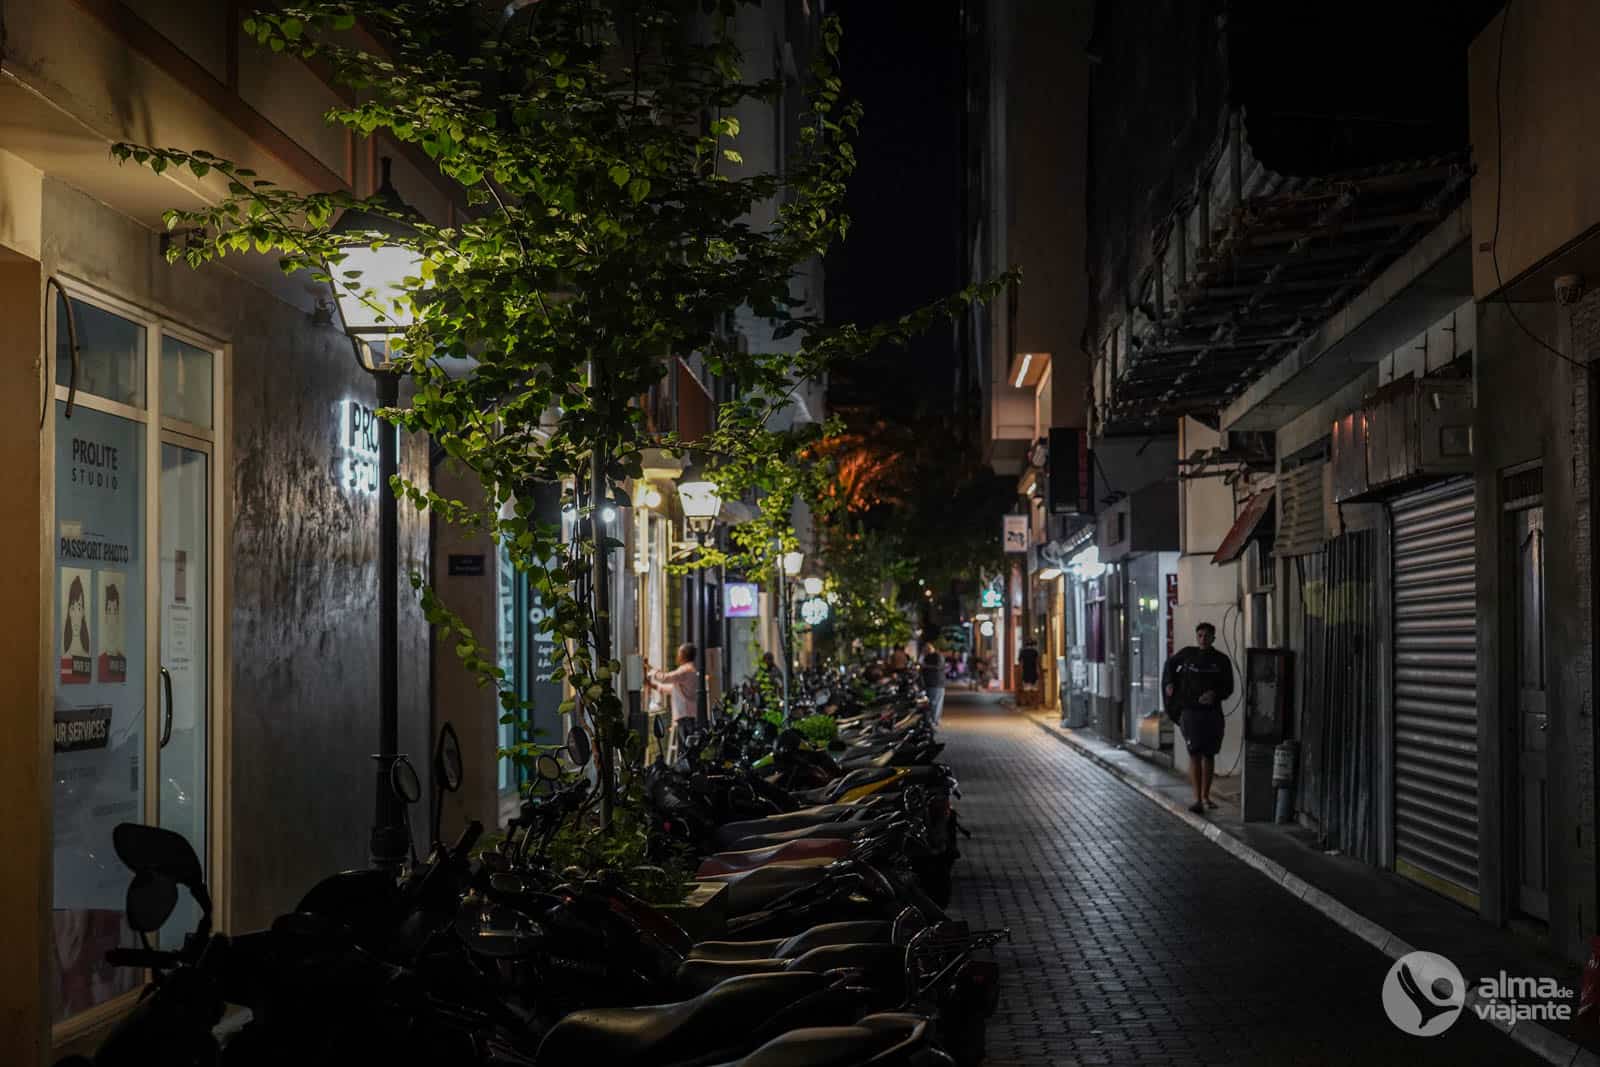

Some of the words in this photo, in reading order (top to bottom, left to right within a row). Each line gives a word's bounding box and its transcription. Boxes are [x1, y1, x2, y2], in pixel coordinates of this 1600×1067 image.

[72, 438, 119, 470] PROLITE
[71, 467, 119, 490] STUDIO
[60, 537, 102, 560] PASSPORT
[103, 542, 129, 563] PHOTO
[55, 721, 67, 743] UR
[67, 719, 106, 742] SERVICES
